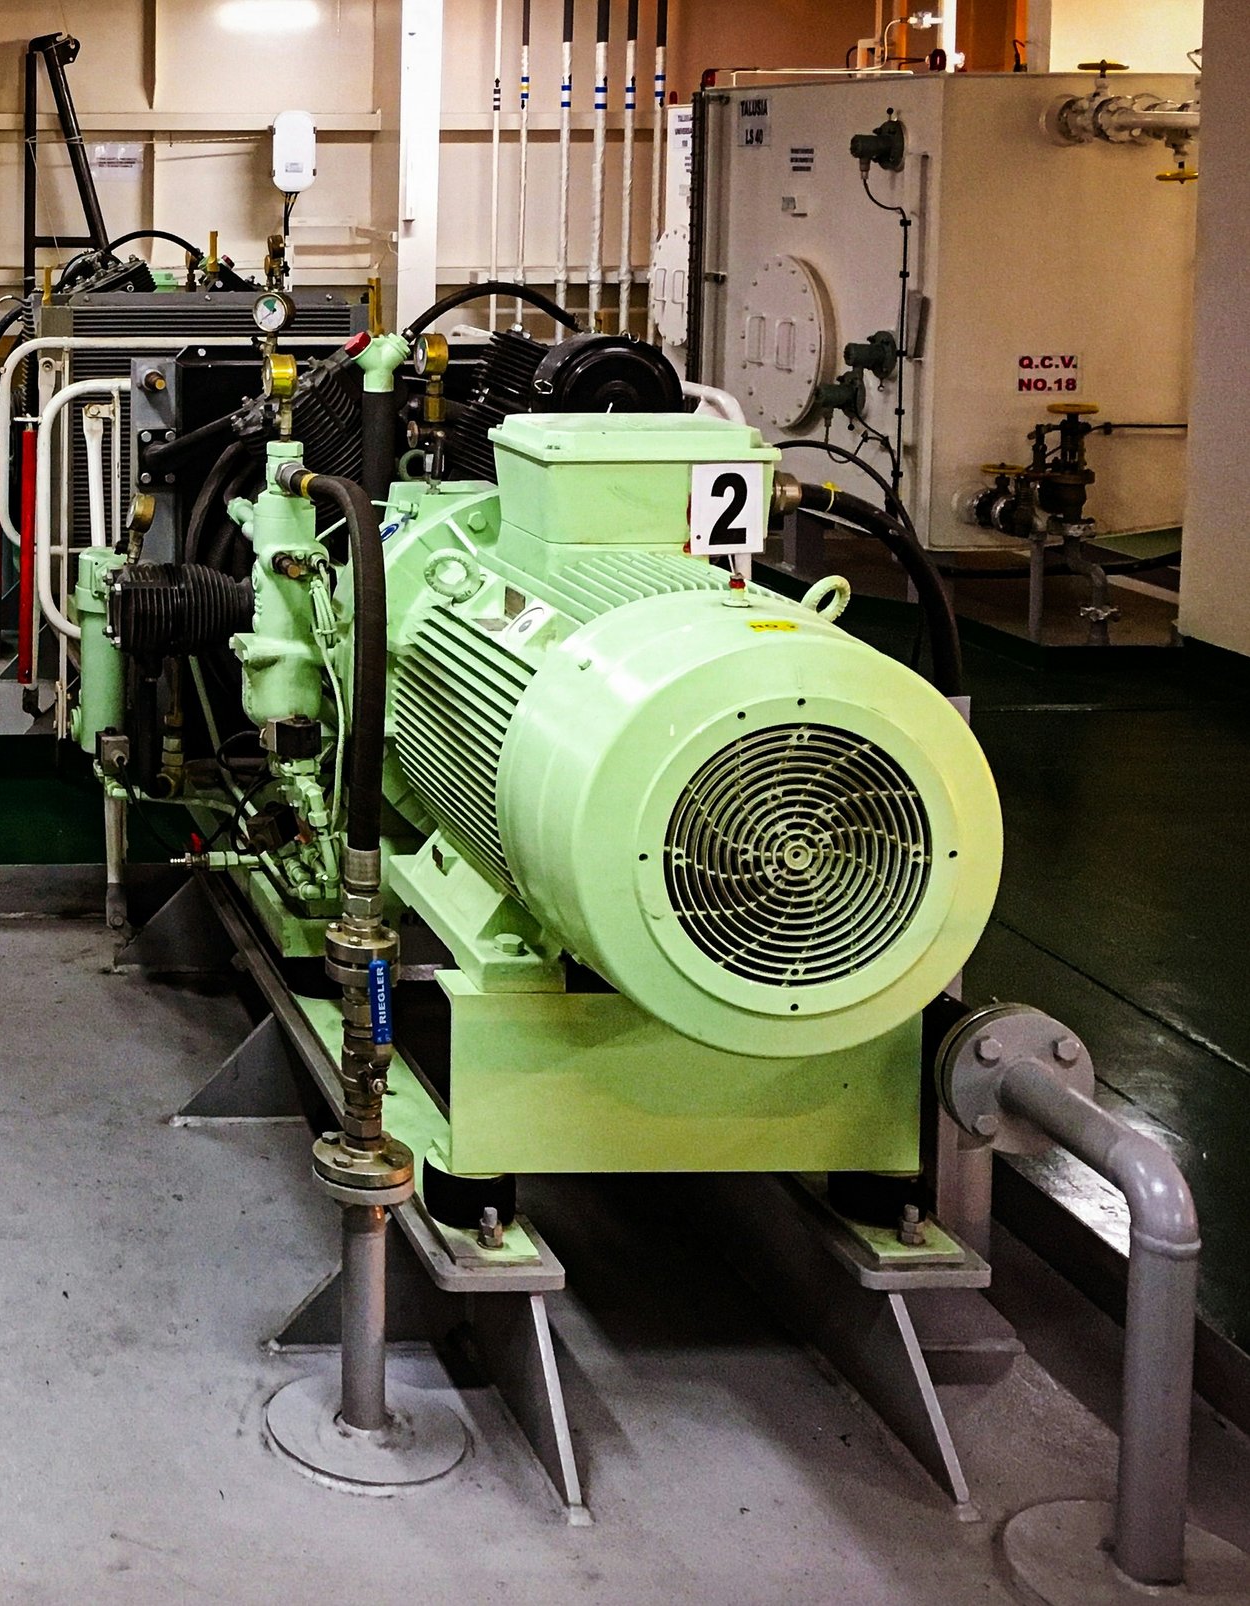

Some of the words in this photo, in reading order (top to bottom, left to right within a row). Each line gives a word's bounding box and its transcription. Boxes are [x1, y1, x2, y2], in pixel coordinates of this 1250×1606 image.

[740, 99, 768, 117] TALUSIA
[745, 129, 754, 145] LS
[1018, 355, 1078, 369] Q.C.V.
[1018, 378, 1077, 391] NO.18
[708, 472, 748, 546] 2
[376, 966, 387, 1025] RIEGLER
